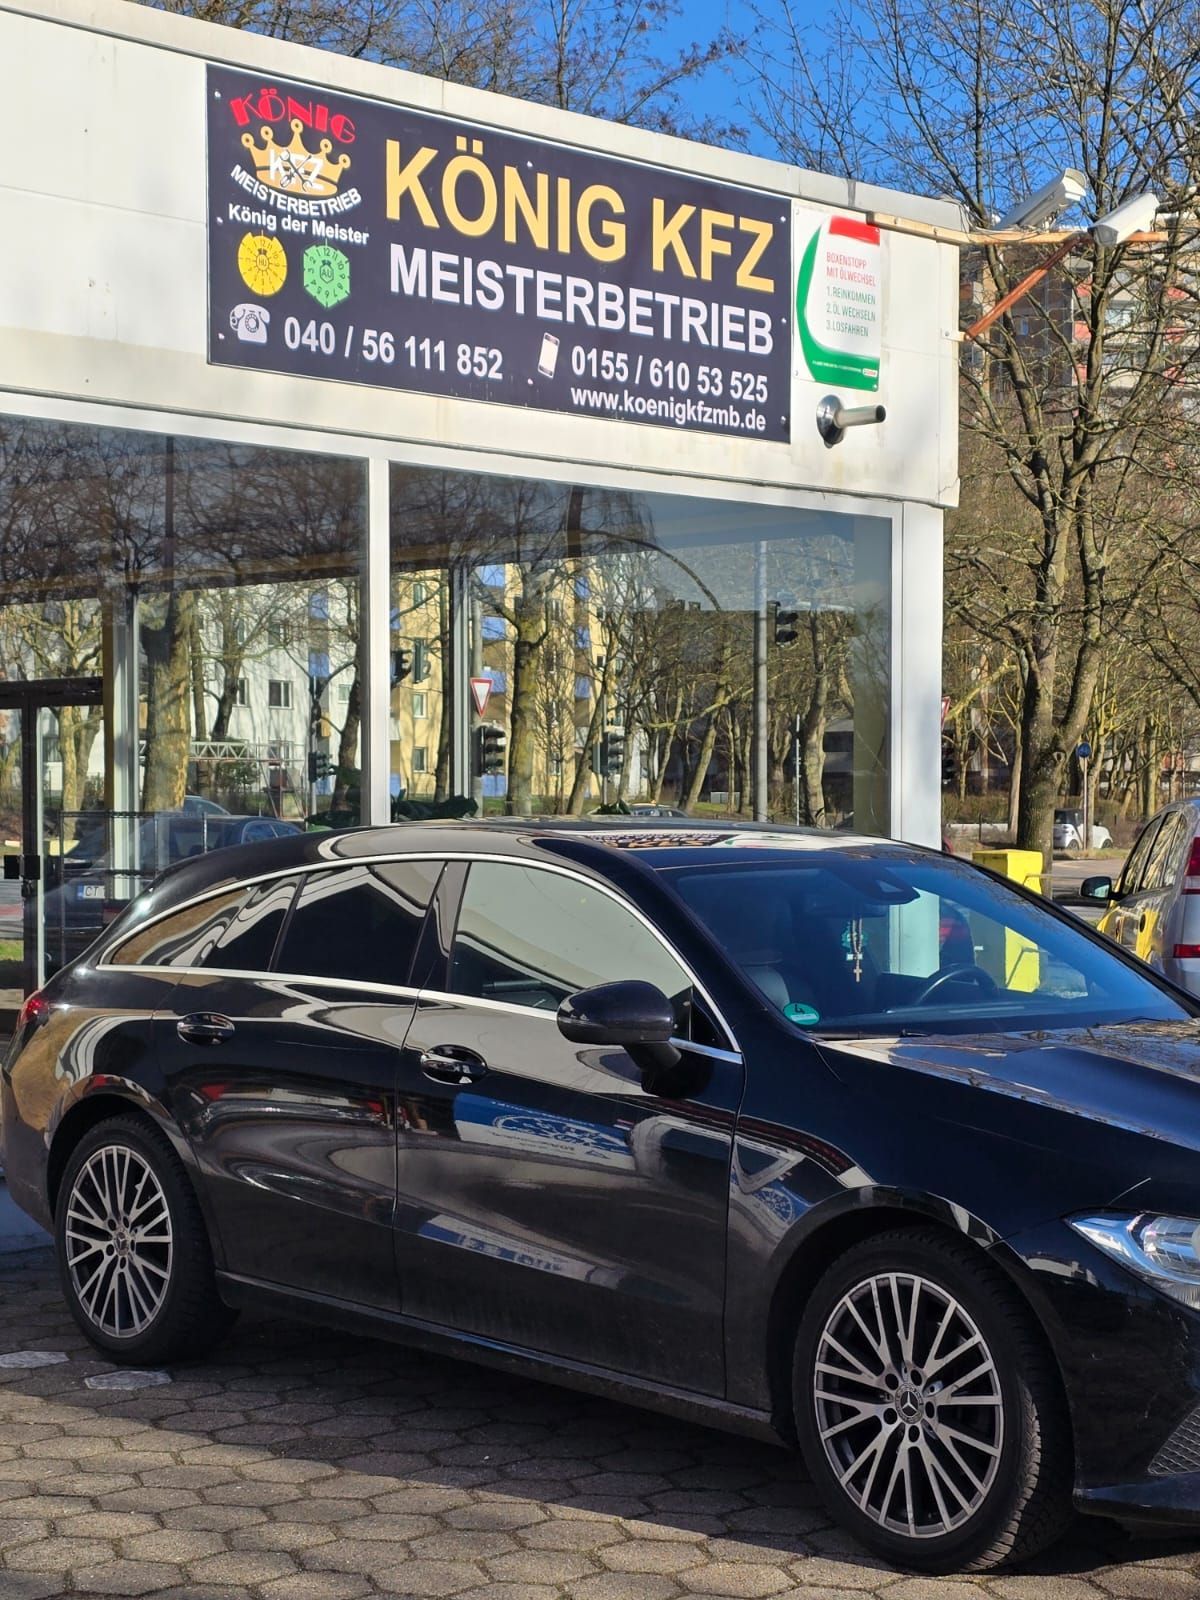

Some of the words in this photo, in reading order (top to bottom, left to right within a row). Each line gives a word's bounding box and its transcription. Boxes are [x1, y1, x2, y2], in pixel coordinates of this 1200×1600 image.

[231, 88, 356, 143] KÖNIG
[230, 164, 363, 217] MEISTERBETRIEB
[386, 135, 627, 262] KÖNIG
[652, 197, 775, 294] KFZ
[228, 203, 277, 231] König
[281, 215, 308, 233] der
[312, 220, 369, 245] Meister
[826, 252, 867, 270] BOXENSTOPP
[826, 267, 838, 278] MIT
[390, 243, 774, 356] MEISTERBETRIEB
[284, 316, 336, 355] 040
[344, 325, 354, 358] /
[362, 329, 395, 364] 56
[405, 335, 445, 372] 111
[457, 344, 503, 379] 852
[571, 345, 629, 382] 0155
[634, 355, 643, 385] /
[650, 358, 690, 391] 610
[697, 366, 723, 396] 53
[730, 371, 768, 403] 525
[571, 387, 766, 431] www.koenigkfzmb.de
